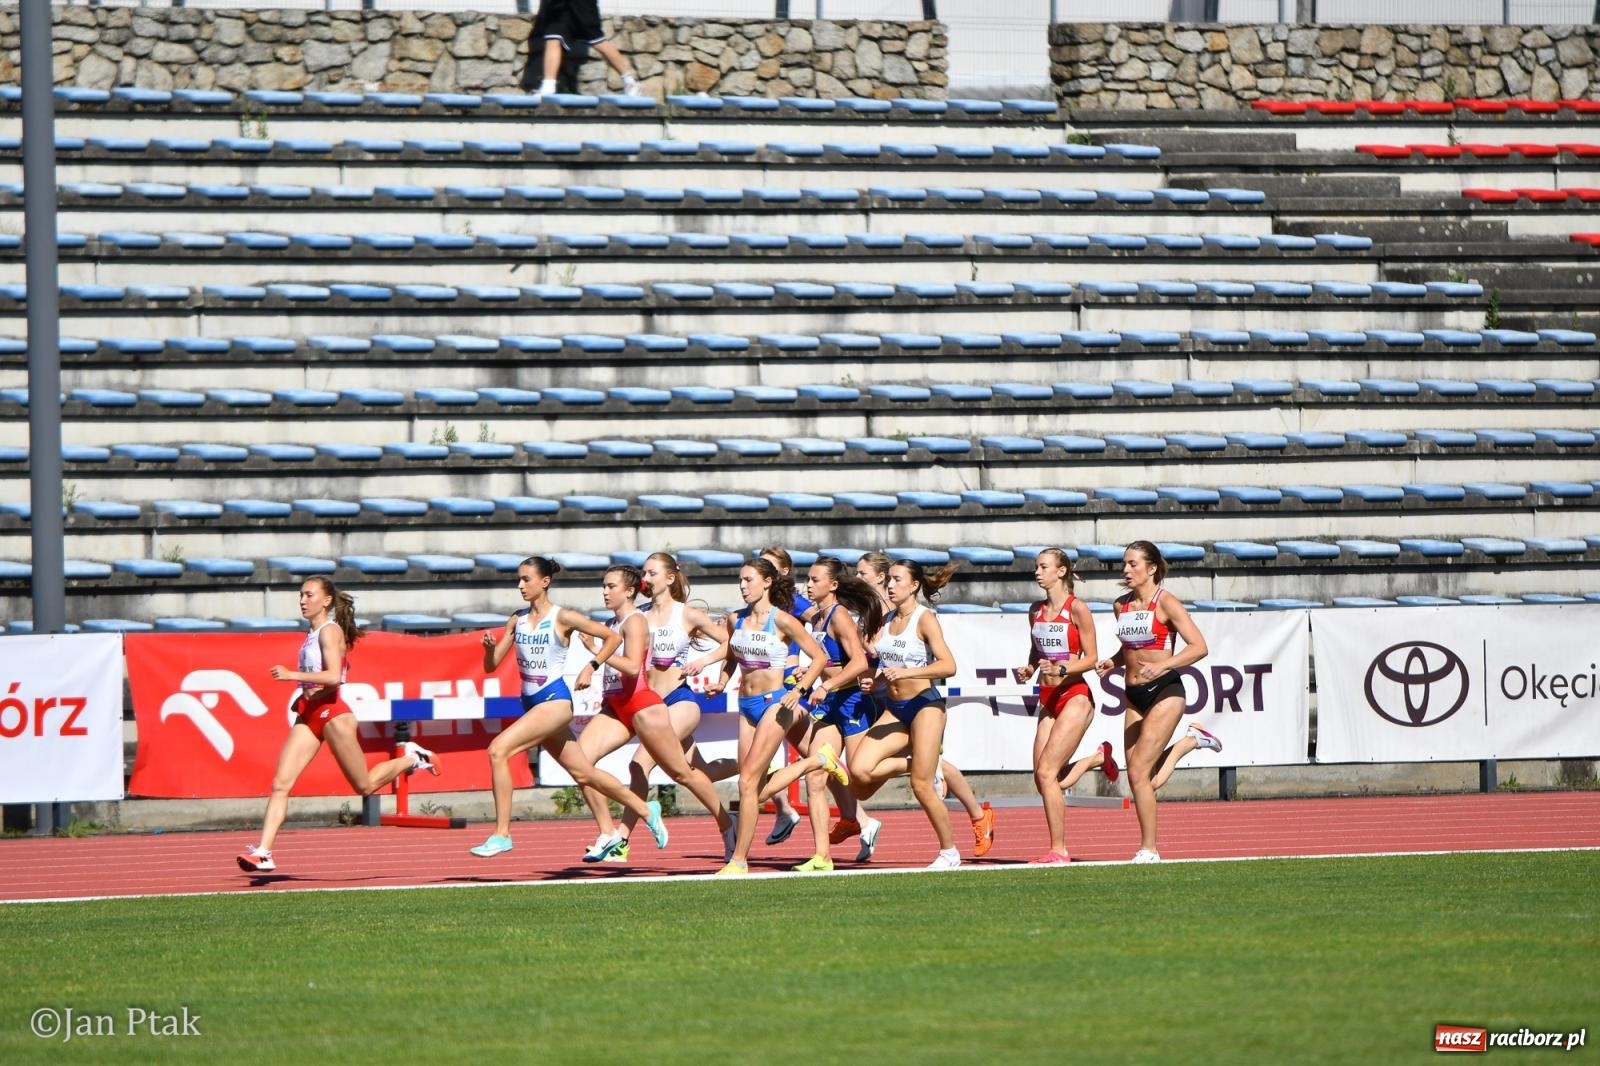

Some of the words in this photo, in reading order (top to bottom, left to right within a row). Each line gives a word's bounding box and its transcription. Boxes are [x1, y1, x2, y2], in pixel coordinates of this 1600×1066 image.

[1048, 624, 1064, 633] 208
[892, 640, 907, 649] 308
[530, 646, 545, 655] 107
[1100, 664, 1272, 717] SORT
[0, 682, 88, 738] órz
